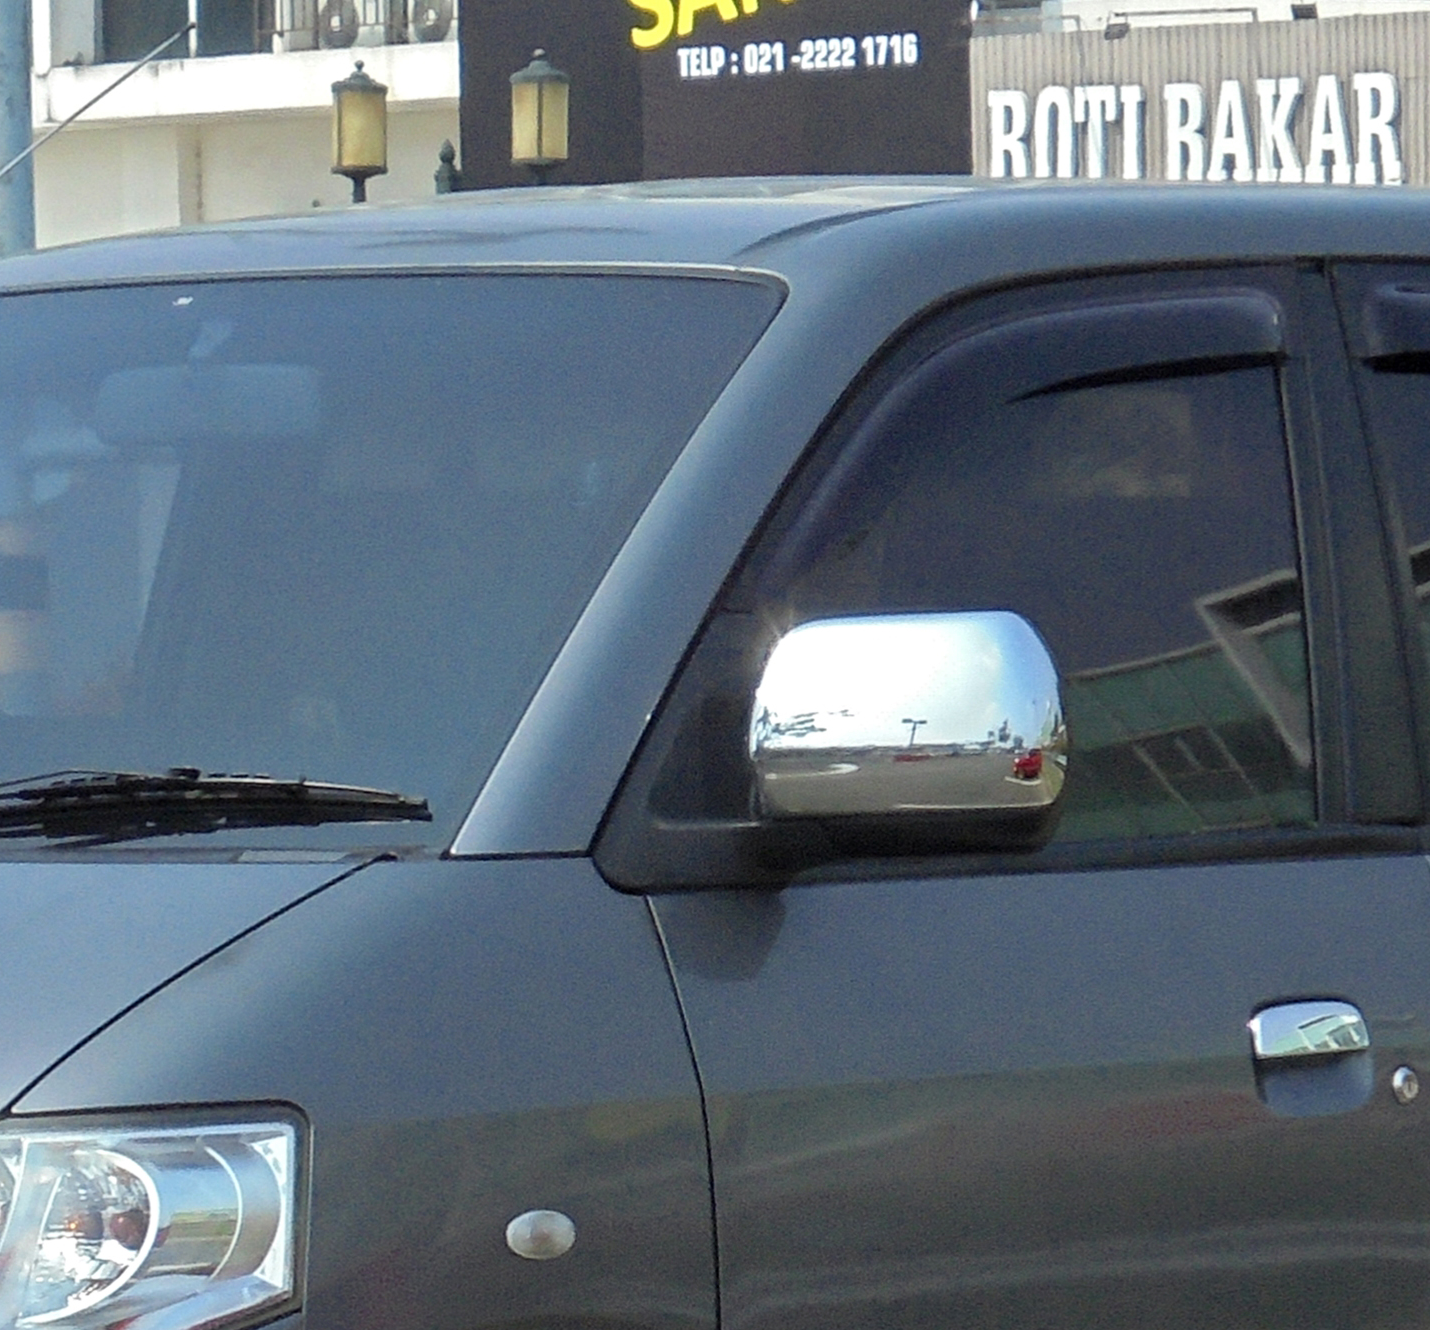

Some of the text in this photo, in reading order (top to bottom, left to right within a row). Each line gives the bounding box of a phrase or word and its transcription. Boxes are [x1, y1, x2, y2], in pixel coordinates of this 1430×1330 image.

[677, 45, 725, 77] TELP
[743, 41, 784, 74] 021
[861, 33, 918, 66] 1716
[988, 84, 1144, 180] ROTI
[1164, 71, 1402, 186] BAKAR
